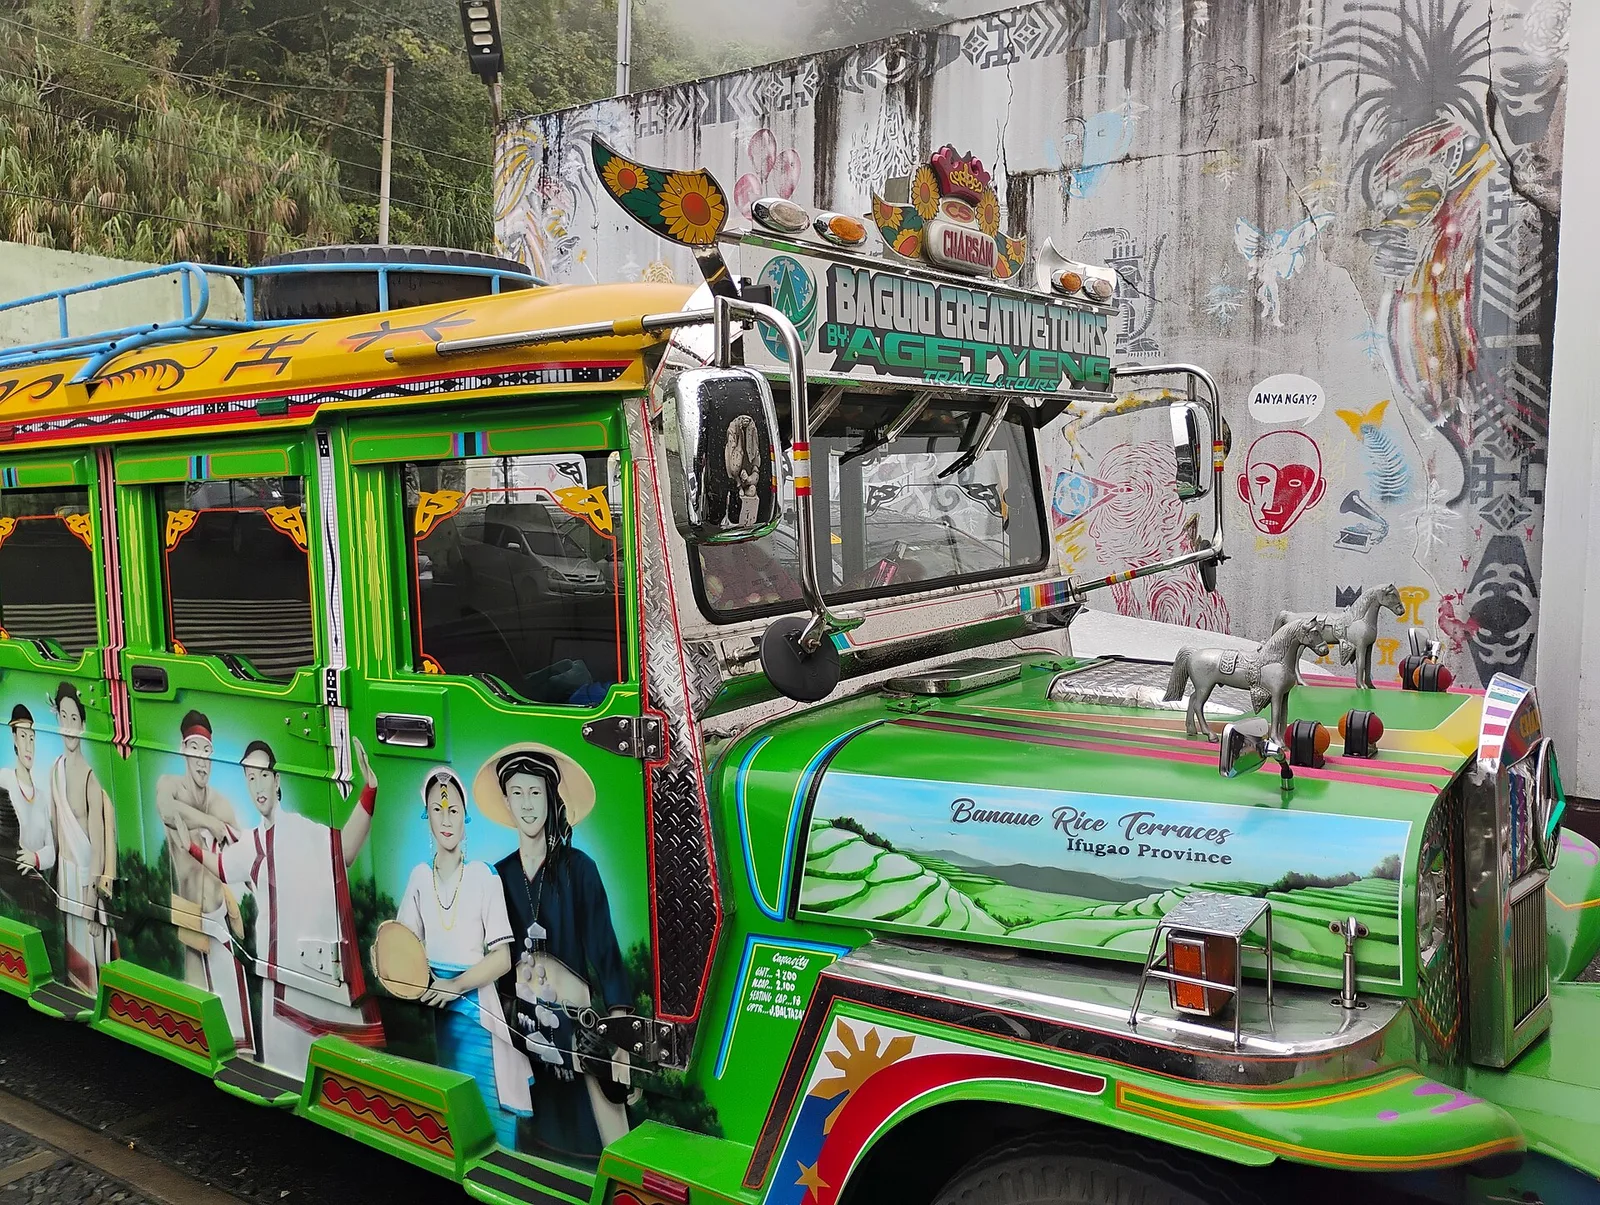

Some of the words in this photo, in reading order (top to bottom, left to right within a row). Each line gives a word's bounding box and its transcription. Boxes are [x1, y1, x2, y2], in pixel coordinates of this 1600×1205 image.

[943, 229, 994, 268] CHARSAM
[834, 266, 936, 336] BAGUIO
[940, 286, 1047, 350] CREATIVE
[1049, 308, 1109, 356] TOURS
[826, 323, 850, 348] BY:
[842, 326, 1111, 385] AGETYENG
[922, 369, 997, 389] TRAVEL
[1003, 375, 1061, 392] TOURS
[950, 797, 1043, 827] Banaue
[1051, 805, 1108, 838] Rice
[1117, 811, 1234, 846] Terraces
[1066, 837, 1130, 858] Ifugao
[1137, 843, 1233, 866] Province
[772, 952, 810, 971] Capacity
[749, 990, 772, 1003] SEATING
